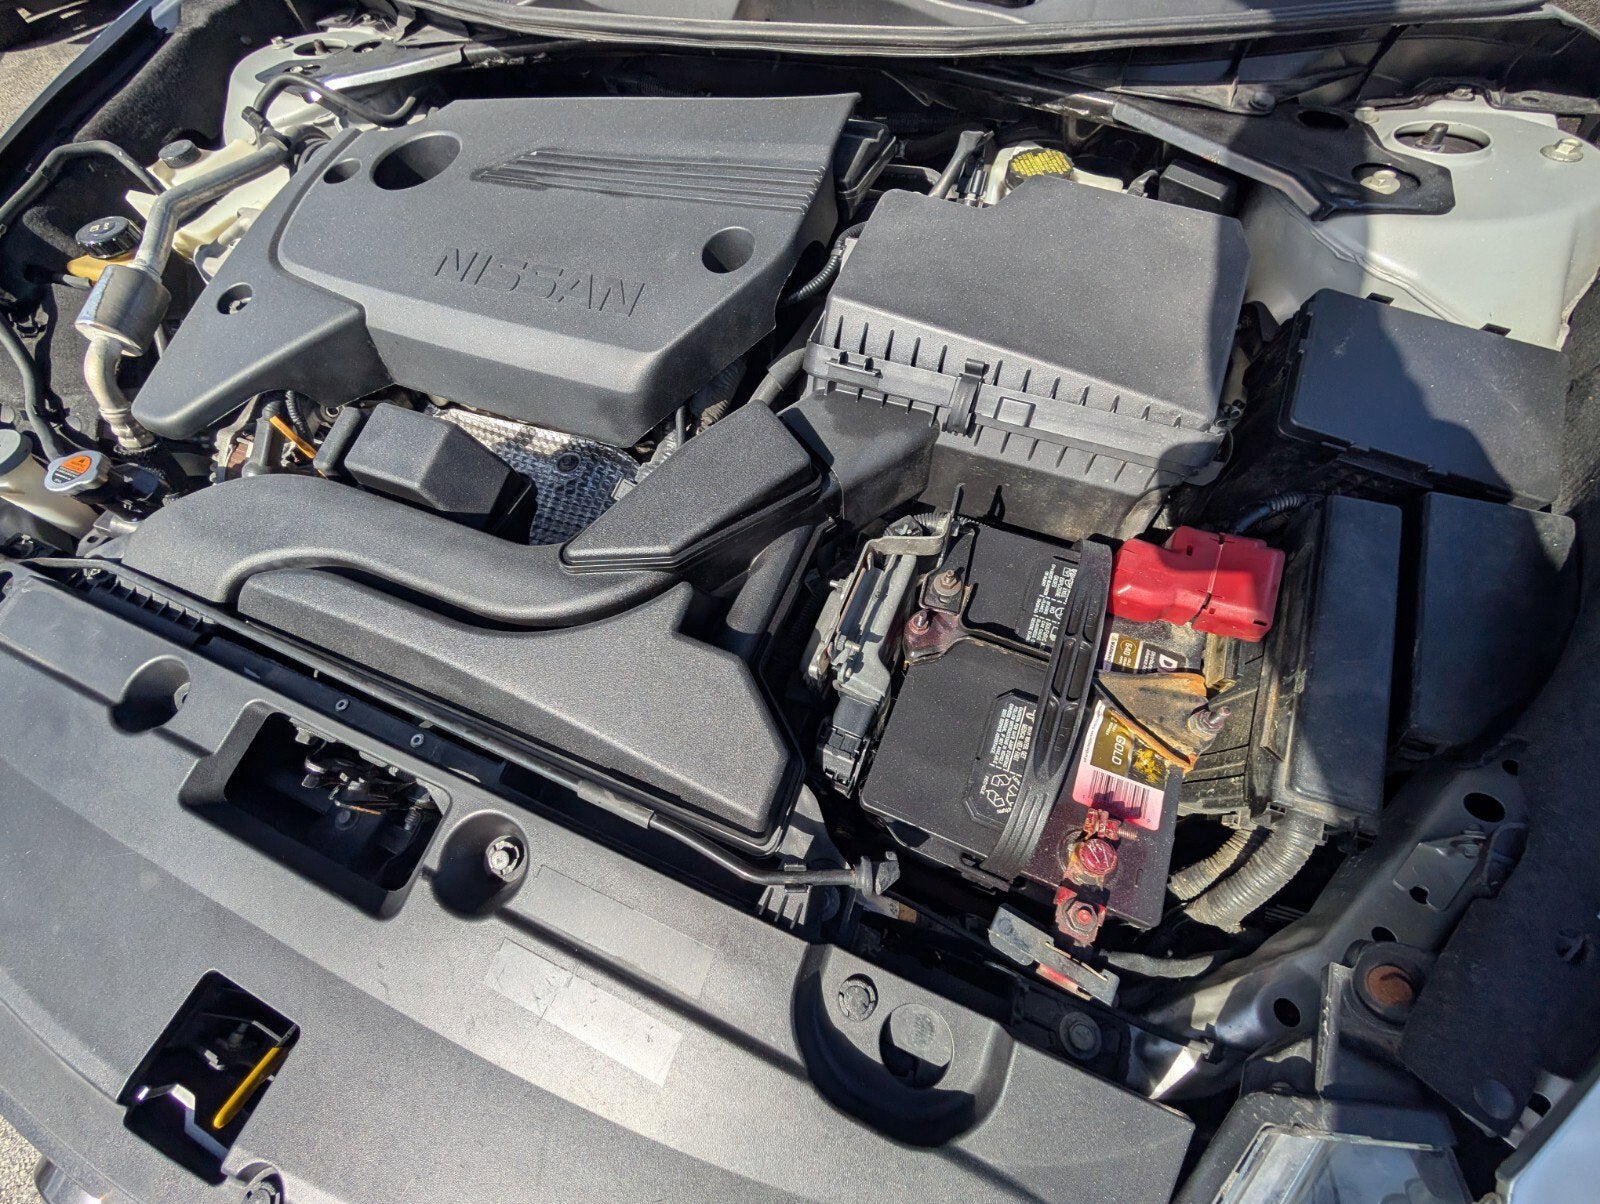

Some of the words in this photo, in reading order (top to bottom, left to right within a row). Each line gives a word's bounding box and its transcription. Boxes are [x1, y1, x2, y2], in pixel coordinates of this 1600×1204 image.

[434, 249, 645, 317] NISSAN
[1123, 642, 1132, 655] 640
[1112, 735, 1126, 764] GOLD
